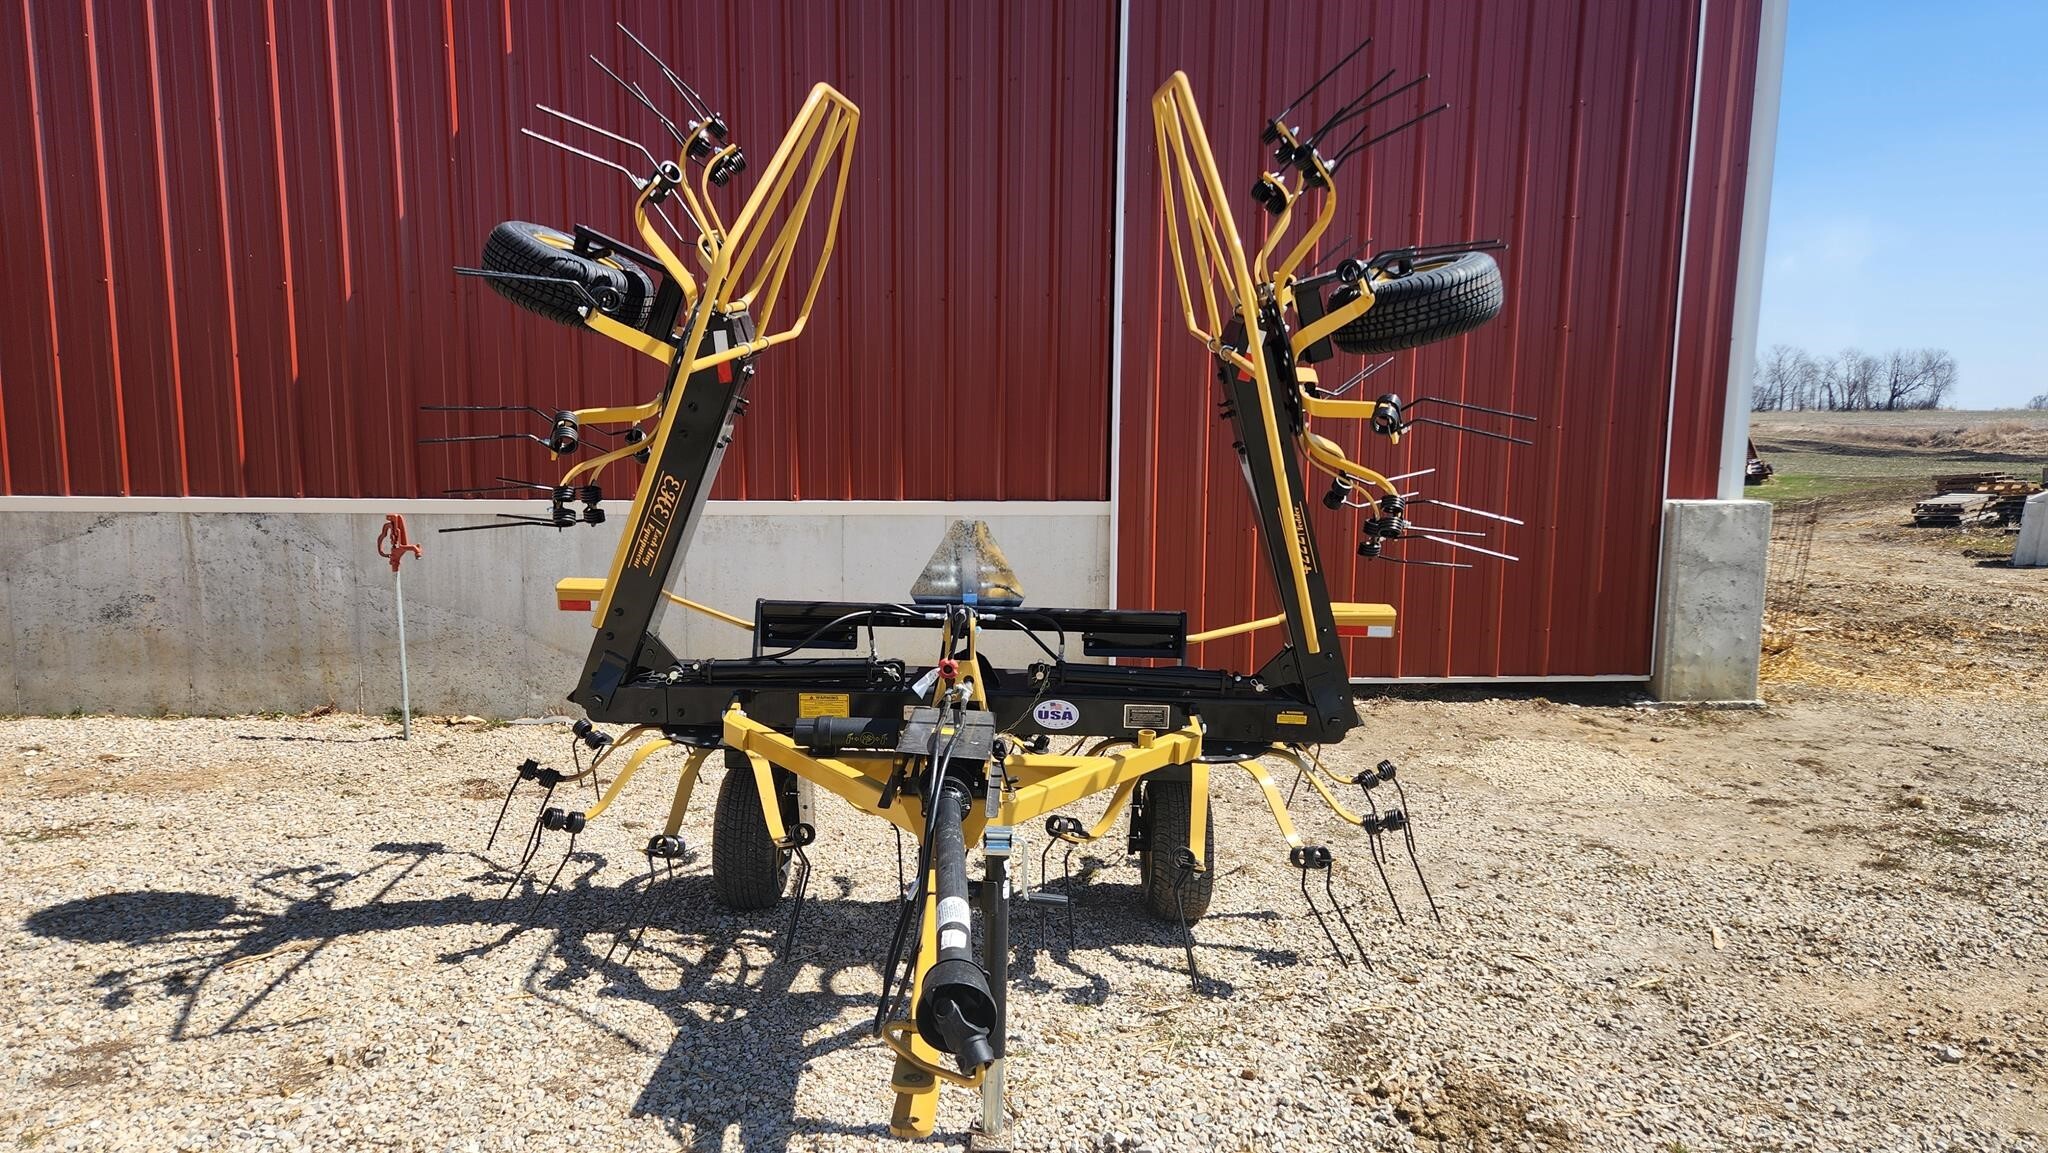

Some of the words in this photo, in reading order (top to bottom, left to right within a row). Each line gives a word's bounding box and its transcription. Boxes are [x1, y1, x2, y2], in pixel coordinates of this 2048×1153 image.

[653, 475, 680, 519] EHE
[1294, 506, 1304, 531] Tedder
[633, 523, 655, 569] Equipment
[650, 528, 663, 548] Esch
[641, 548, 655, 567] Hay
[1037, 710, 1074, 720] USA
